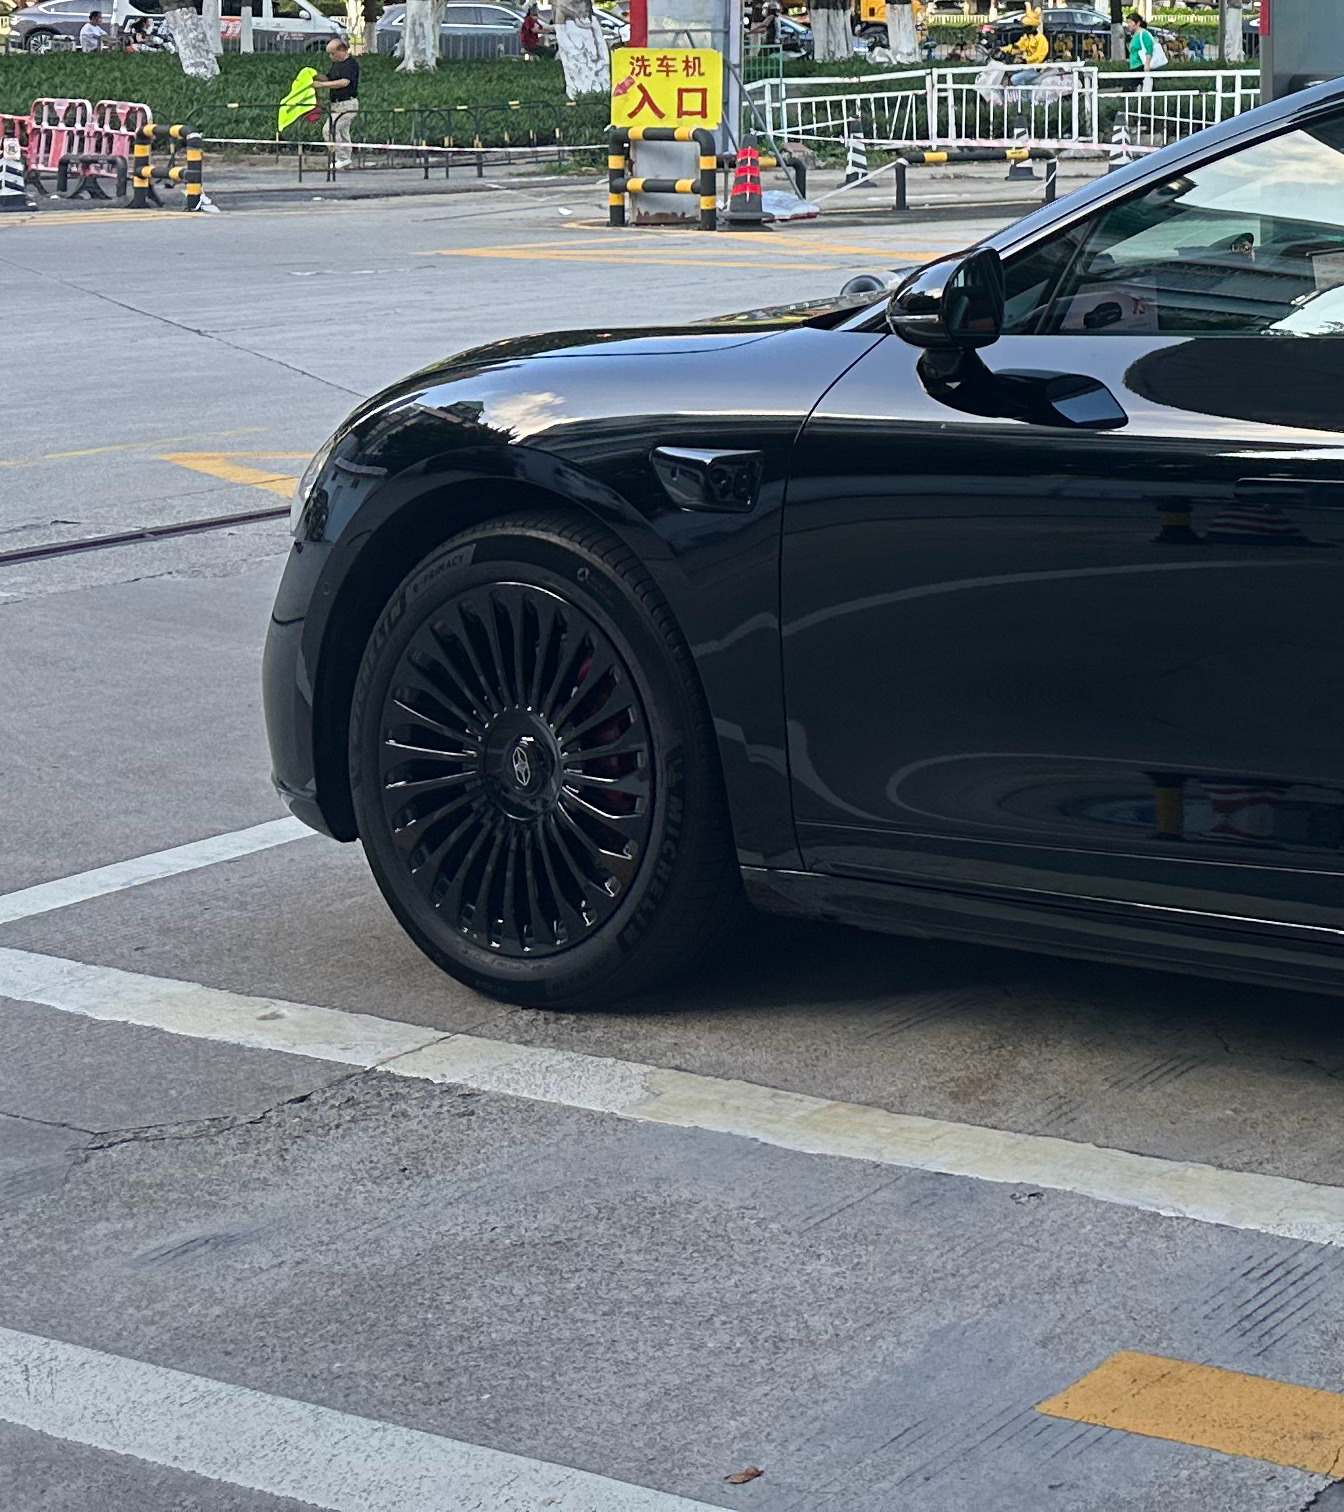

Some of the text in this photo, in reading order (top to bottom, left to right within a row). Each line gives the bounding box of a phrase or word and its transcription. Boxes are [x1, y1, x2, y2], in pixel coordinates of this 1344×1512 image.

[629, 54, 705, 77] 洗车机
[627, 82, 708, 119] 入口
